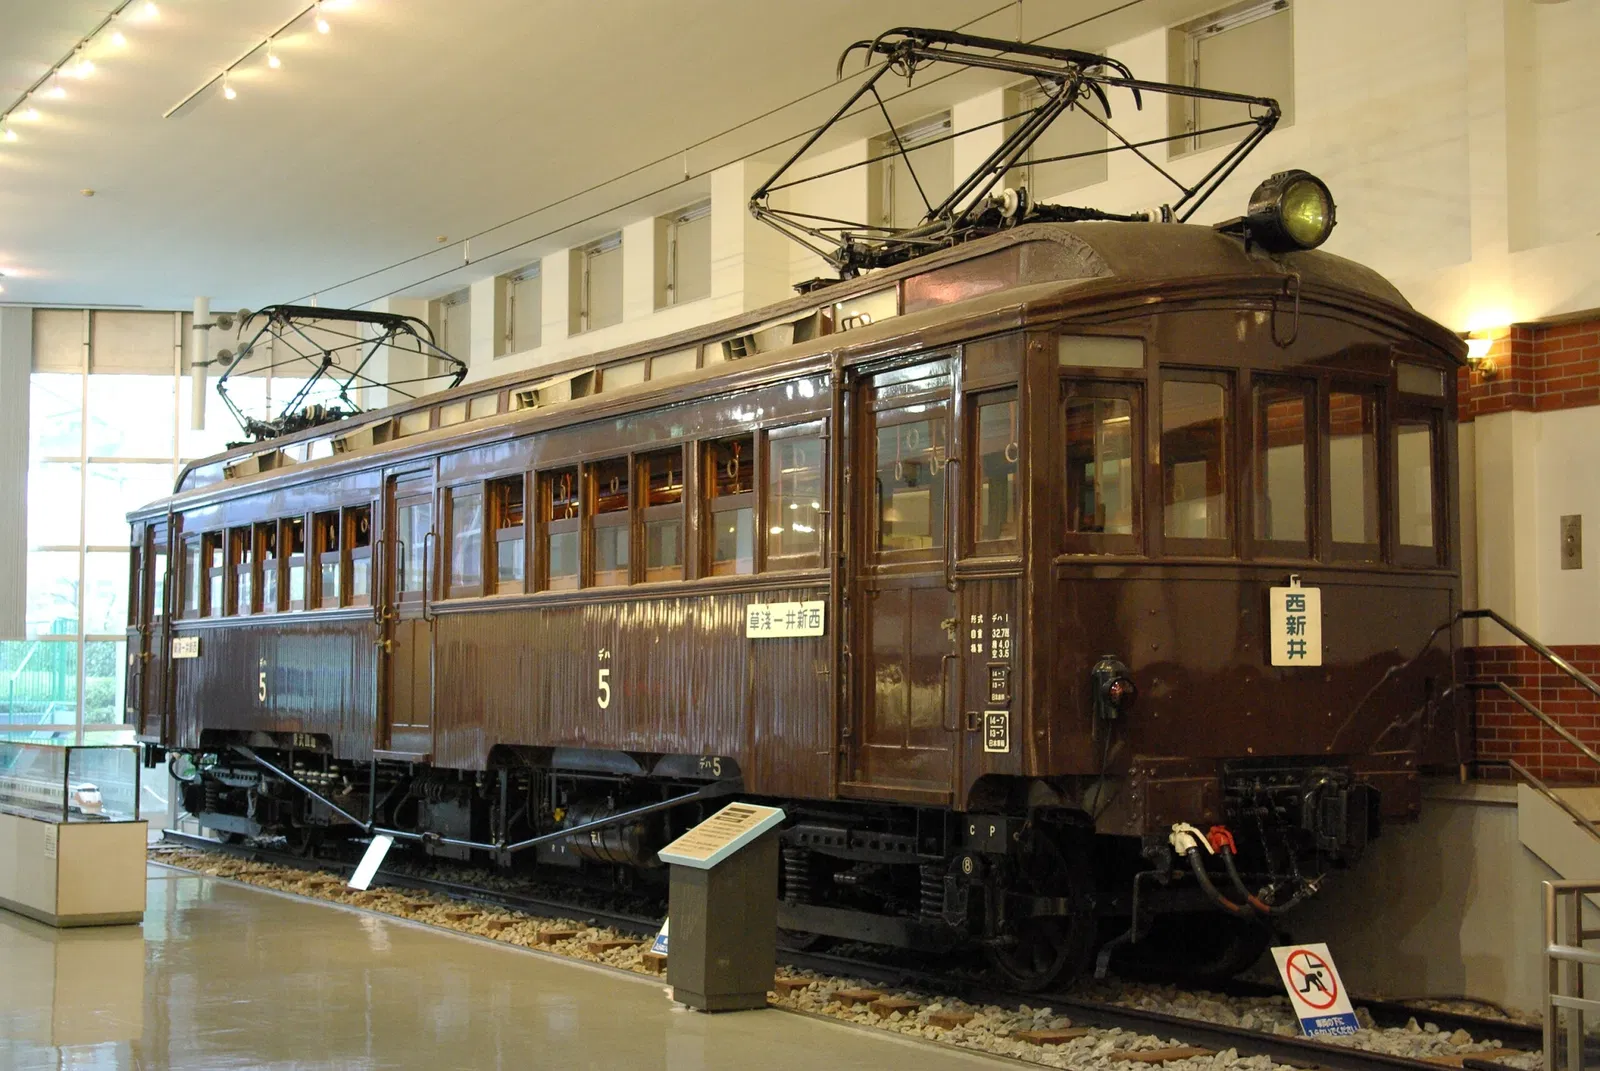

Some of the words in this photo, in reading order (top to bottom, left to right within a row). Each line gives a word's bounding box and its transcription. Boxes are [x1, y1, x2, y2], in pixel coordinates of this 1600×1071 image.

[1285, 593, 1307, 660] 西新井
[259, 672, 266, 701] 5
[597, 668, 611, 709] 5
[970, 825, 975, 835] C
[990, 826, 995, 837] P
